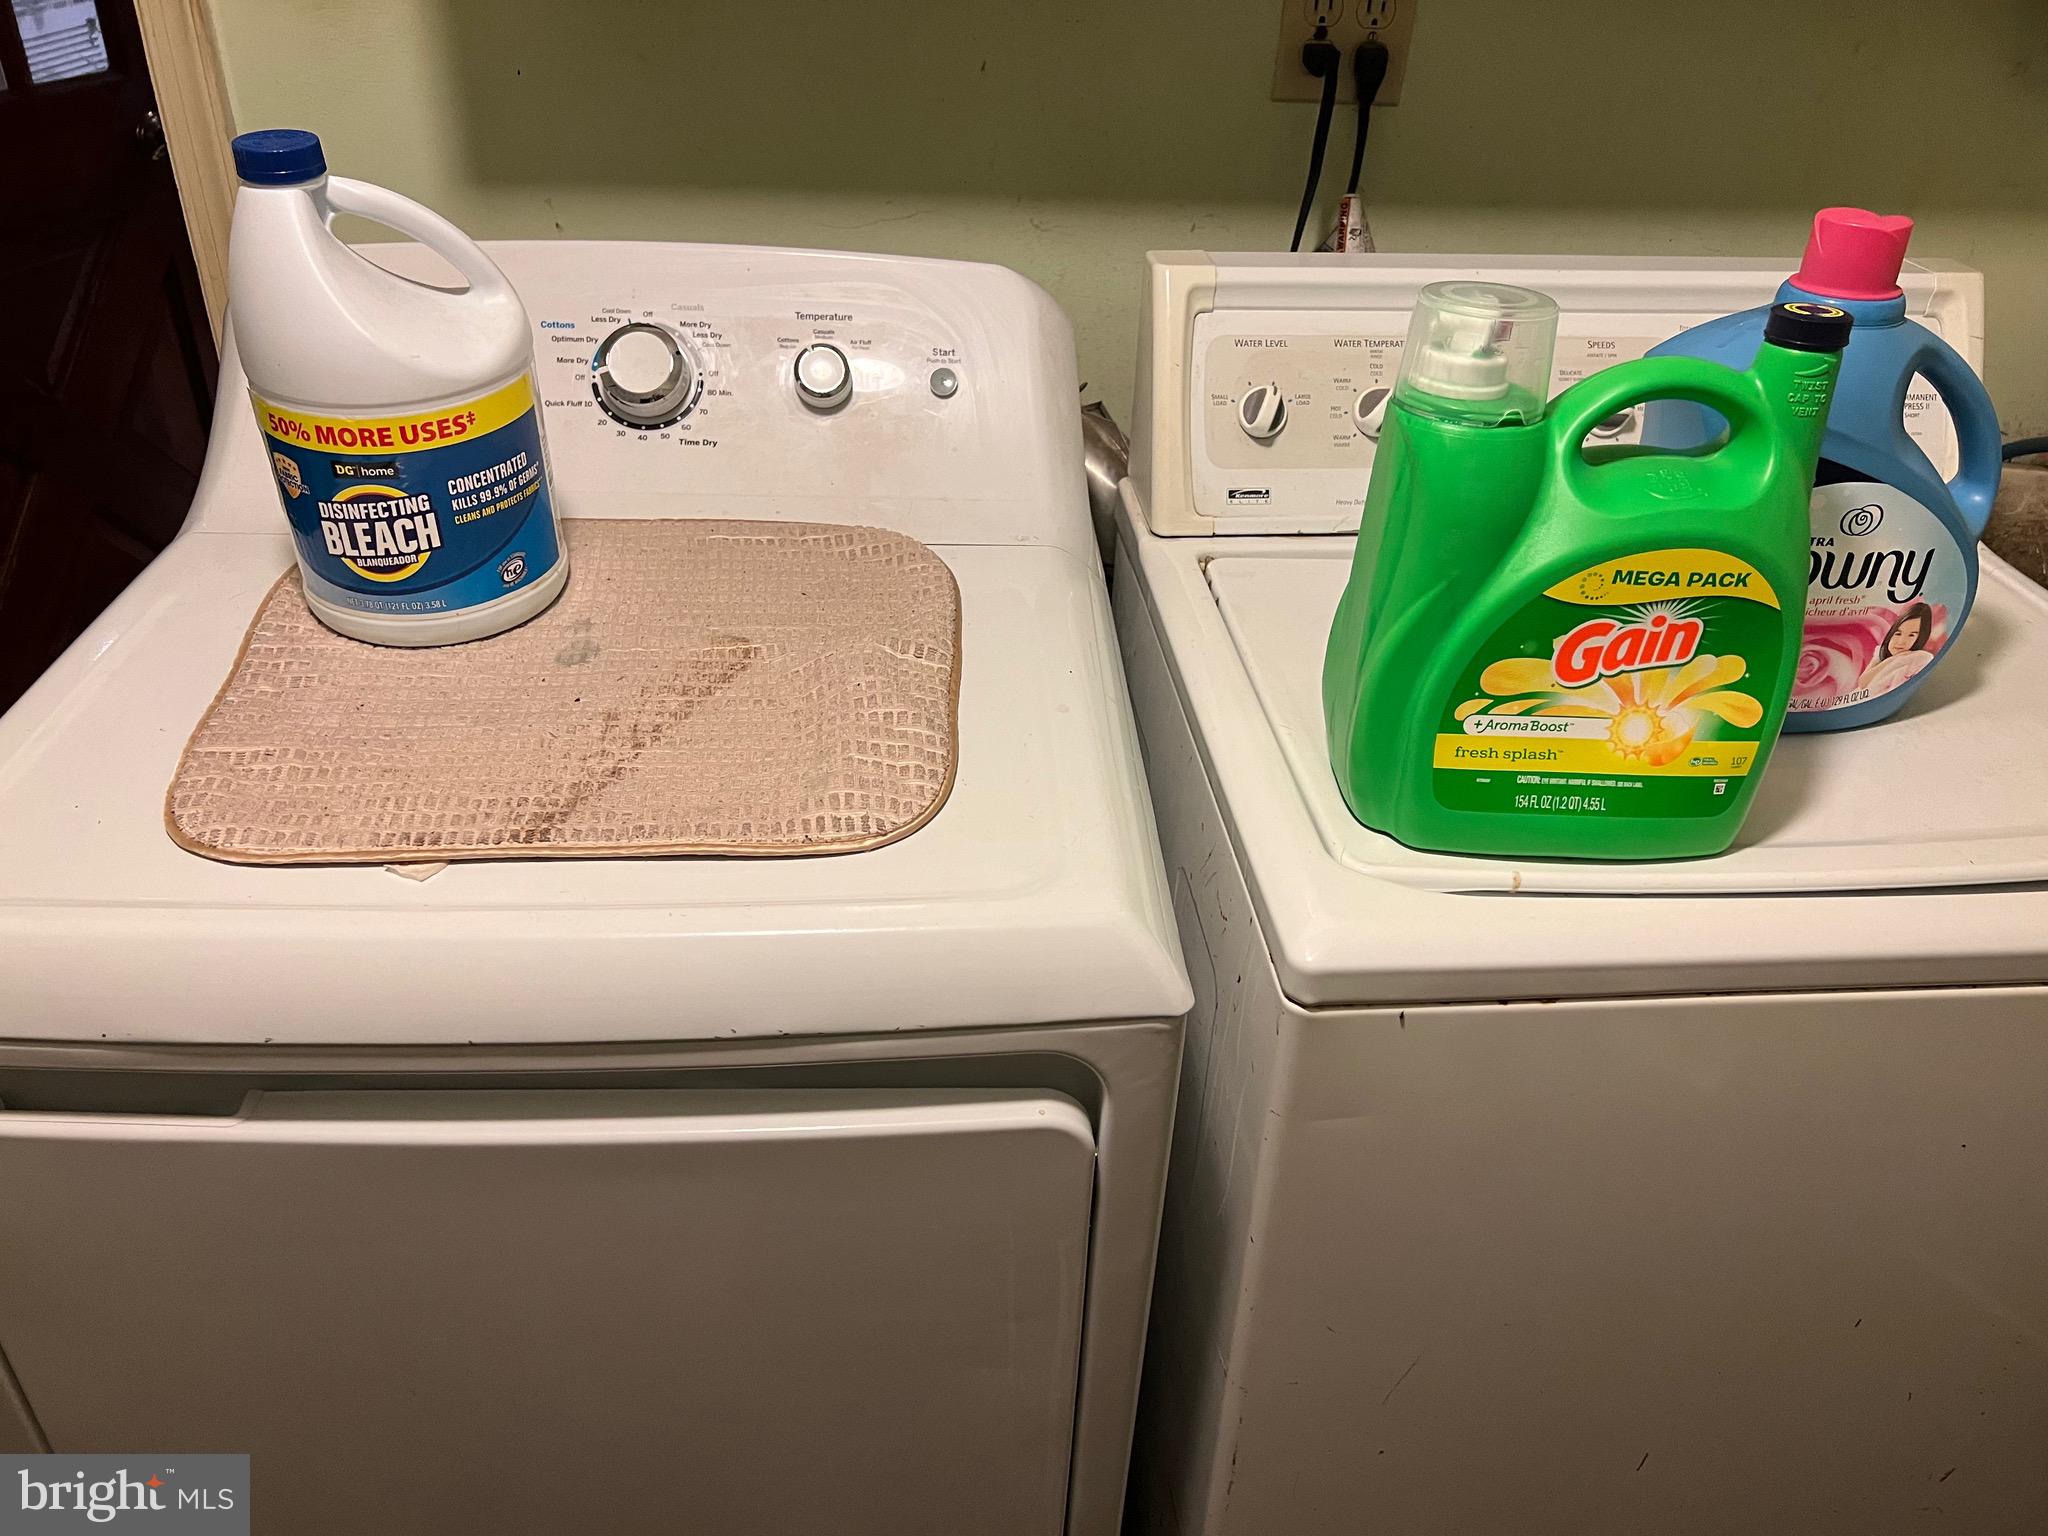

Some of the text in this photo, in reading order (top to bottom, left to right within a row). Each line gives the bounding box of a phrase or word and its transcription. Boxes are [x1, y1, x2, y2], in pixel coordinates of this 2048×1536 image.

[670, 303, 704, 312] Casuals
[642, 310, 653, 318] Off
[794, 312, 853, 322] Temperature
[540, 320, 576, 329] Cottons
[607, 316, 621, 324] Dry
[680, 320, 698, 328] More
[551, 336, 599, 344] Optimum Dry
[708, 332, 722, 340] Dry
[1234, 338, 1288, 348] WATER LEVEL
[1334, 339, 1404, 348] WATER TEMPERAT
[1587, 340, 1616, 350] SPEEDS
[932, 347, 955, 356] Start
[1369, 362, 1384, 370] COLD
[544, 400, 566, 408] Quick
[584, 400, 593, 408] 10
[1904, 402, 1924, 410] PRESS
[699, 408, 708, 416] 70
[268, 412, 311, 442] 50%
[314, 424, 394, 448] MORE
[638, 434, 648, 442] 40
[660, 432, 670, 440] 50
[678, 438, 718, 448] Time Dry
[360, 466, 394, 476] home
[447, 451, 527, 496] CONCENTRATED
[451, 494, 478, 511] KILLS
[480, 482, 508, 503] 99.9%
[508, 477, 518, 492] OF
[1232, 491, 1270, 499] Kenmore
[318, 494, 430, 520] DISINFECTING
[454, 510, 481, 525] CLEANS
[482, 505, 496, 518] AND
[496, 493, 524, 512] PROTECTS
[320, 512, 442, 558] BLEACH
[1810, 537, 1834, 547] TRA
[356, 554, 418, 568] BLANQUEADOR
[1612, 569, 1752, 588] MEGA PACK
[1808, 548, 1936, 604] owny
[384, 601, 400, 610] (121
[401, 602, 410, 610] FL
[411, 602, 424, 610] OZ)
[425, 600, 440, 610] 3.58
[441, 600, 447, 608] L
[1808, 596, 1834, 606] april
[1554, 614, 1703, 685] Gain
[1454, 746, 1499, 758] fresh
[1732, 756, 1748, 766] 107
[1514, 795, 1606, 812] 154 FL OZ (1.2 QT) 4.55 L
